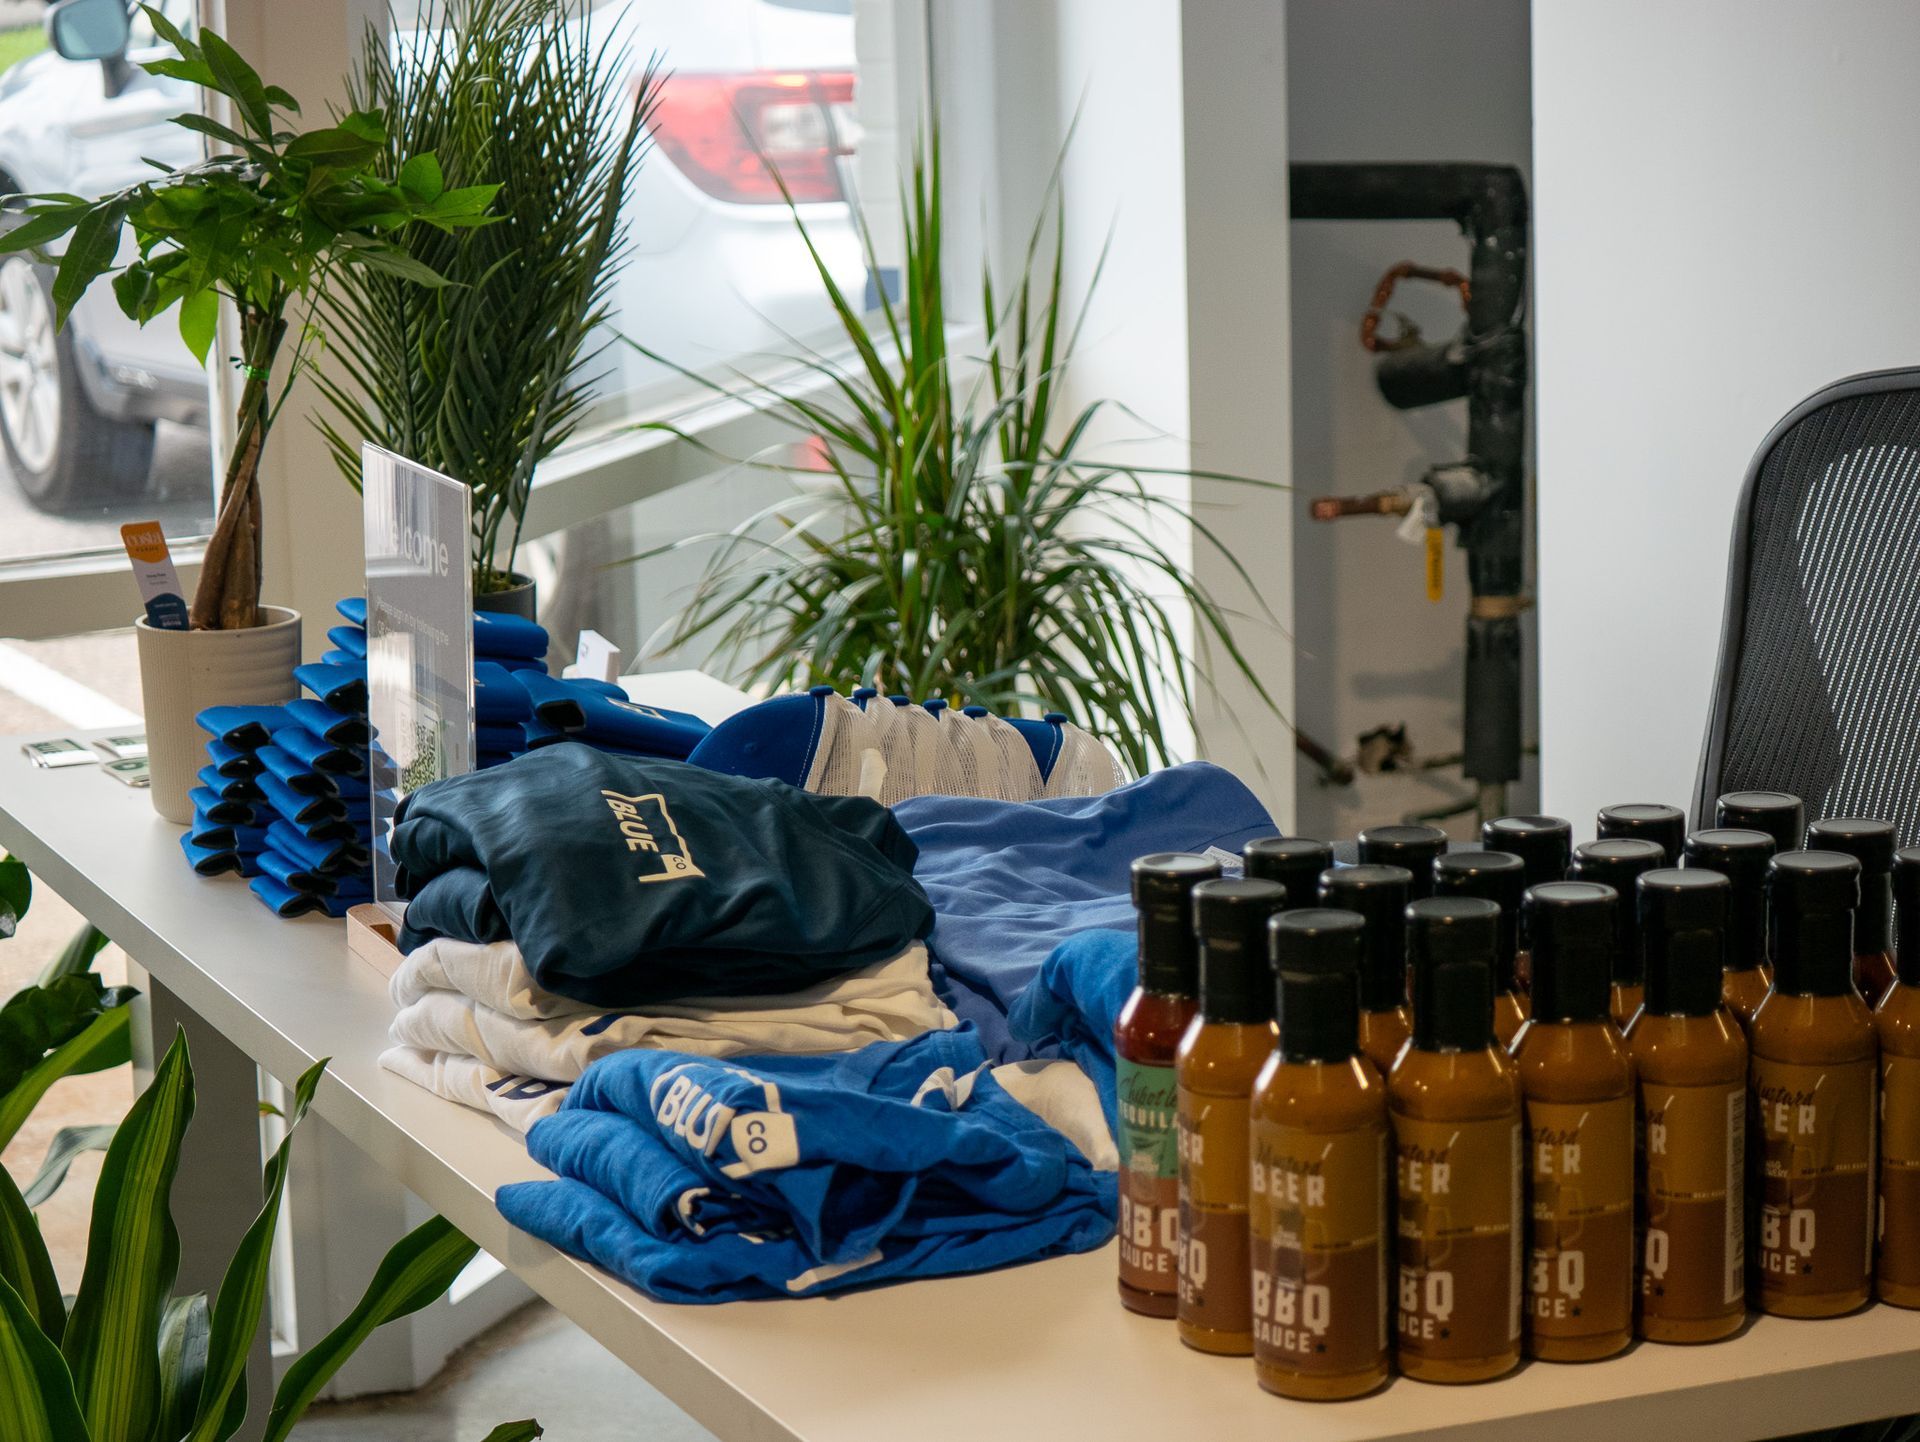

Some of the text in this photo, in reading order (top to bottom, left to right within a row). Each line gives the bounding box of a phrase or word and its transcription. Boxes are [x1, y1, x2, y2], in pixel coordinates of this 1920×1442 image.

[388, 510, 449, 578] elcome
[606, 798, 659, 853] BLUE
[673, 856, 686, 870] CO
[1757, 1075, 1825, 1106] ustard
[746, 1120, 767, 1155] CO
[1538, 1143, 1581, 1175] ER
[1252, 1161, 1325, 1207] BEER
[1121, 1195, 1179, 1256] BBQ
[1761, 1208, 1816, 1259] BQ
[1121, 1243, 1168, 1273] SAUCE
[1532, 1250, 1584, 1300] BQ
[1252, 1270, 1330, 1336] BBQ
[1398, 1271, 1453, 1322] BQ
[1252, 1318, 1311, 1354] SAUCE
